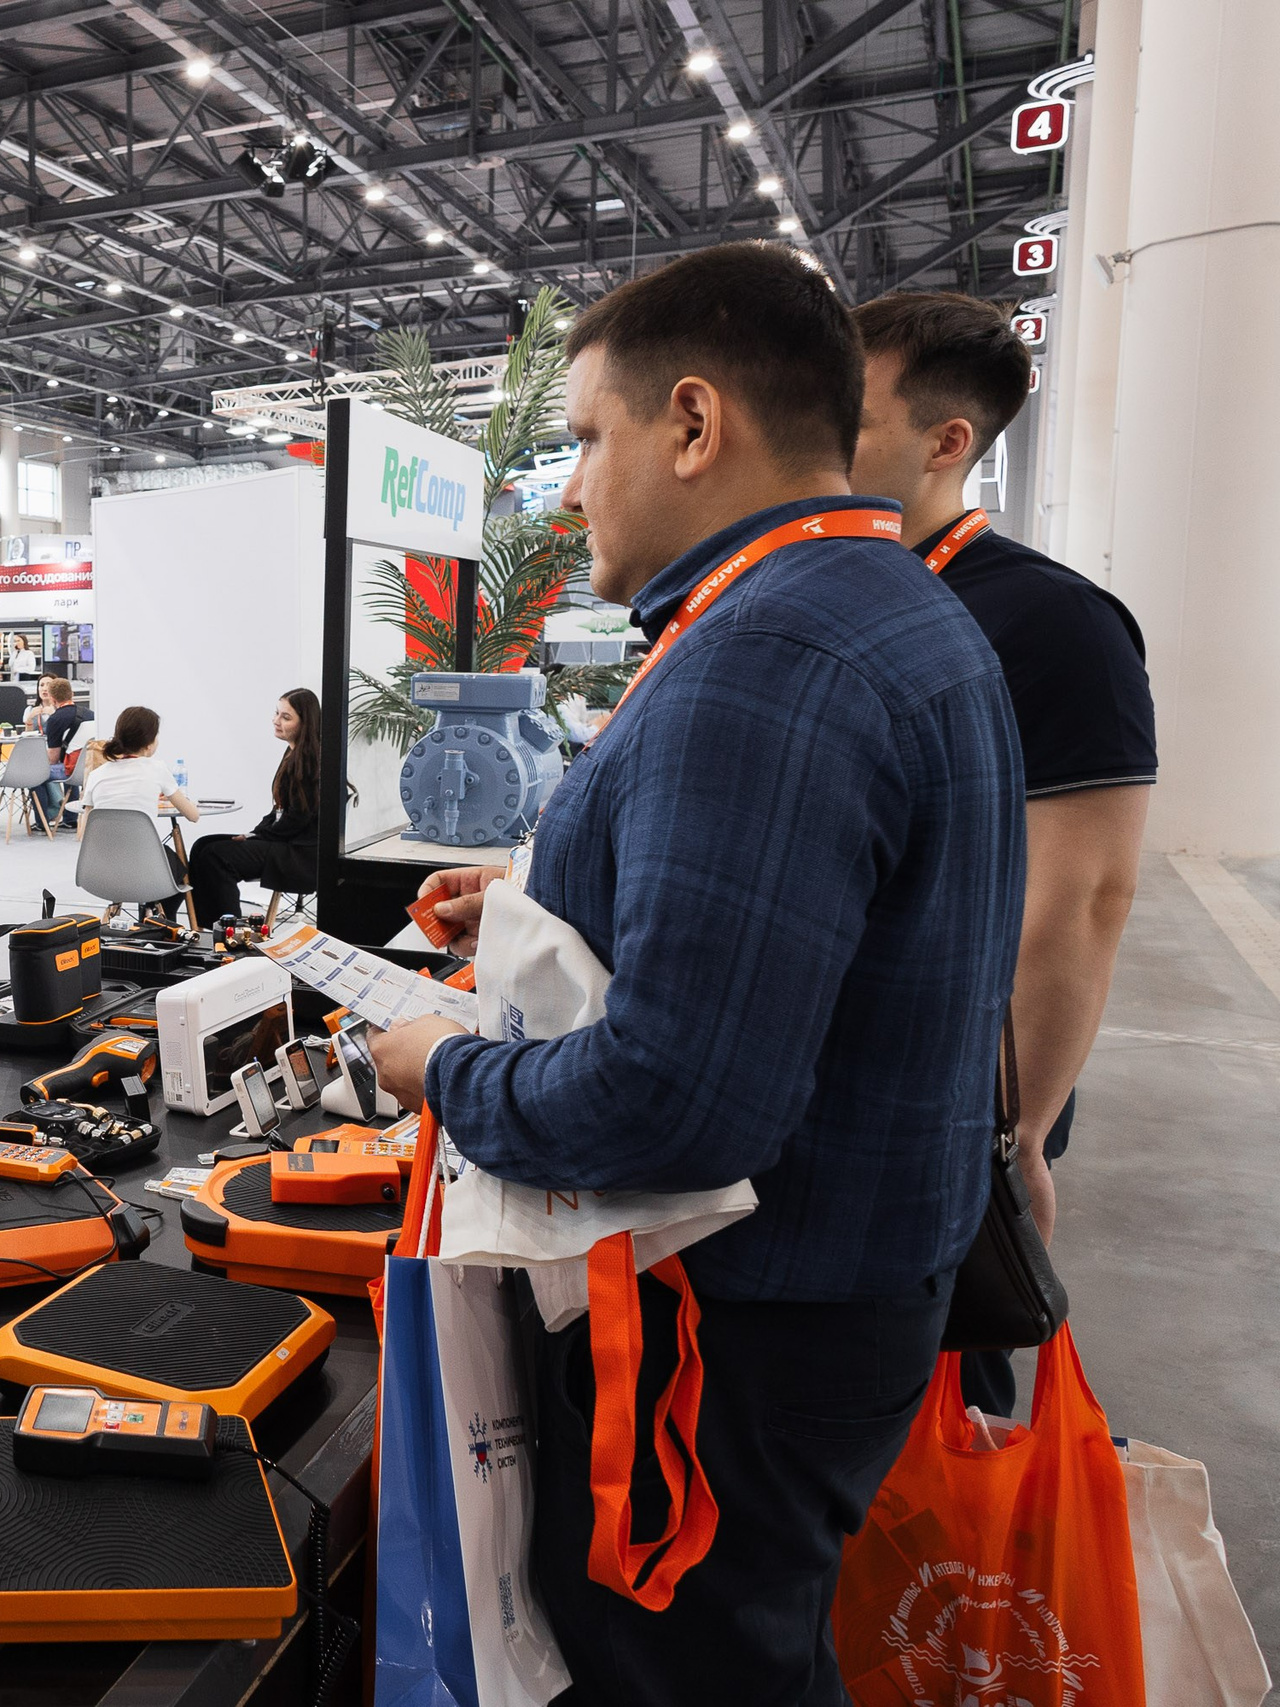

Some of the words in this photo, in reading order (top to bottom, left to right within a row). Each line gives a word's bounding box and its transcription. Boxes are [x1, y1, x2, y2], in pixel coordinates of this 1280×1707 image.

[1027, 110, 1052, 141] 4
[1027, 244, 1045, 268] 3
[1021, 319, 1037, 339] 2
[380, 446, 466, 531] RefComp
[685, 554, 748, 614] МАГАЗИН
[53, 598, 79, 607] лари
[669, 620, 681, 635] И
[623, 641, 665, 696] РЕСТО
[492, 1415, 525, 1431] КОМПОНЕНТ
